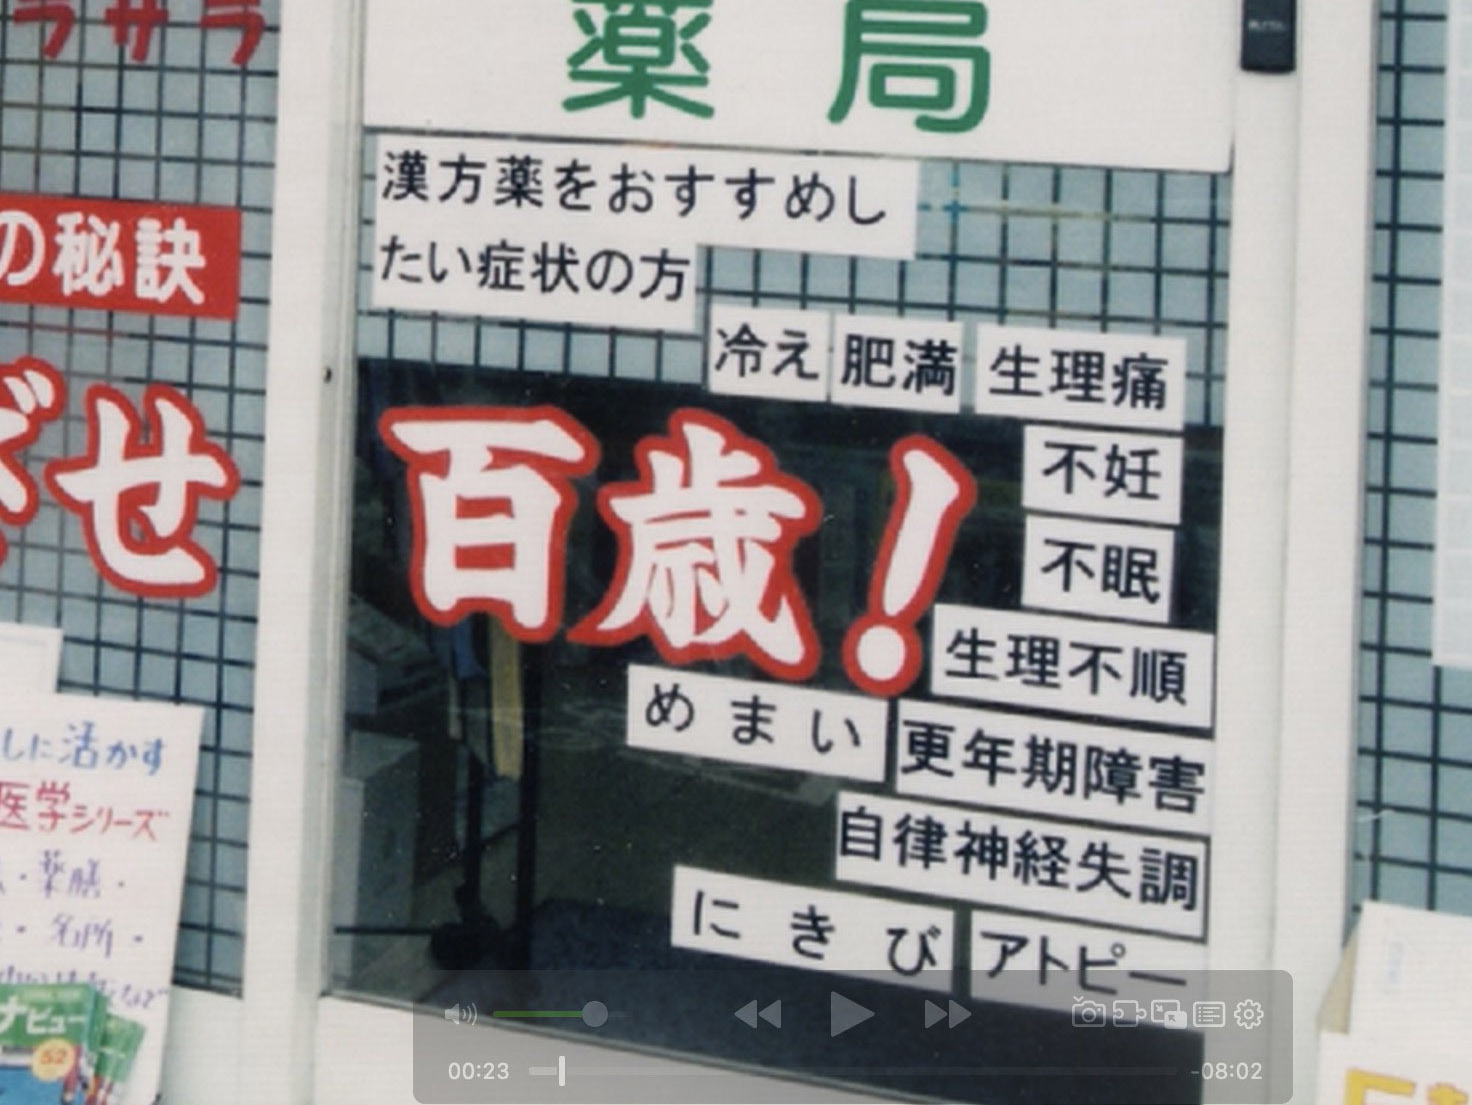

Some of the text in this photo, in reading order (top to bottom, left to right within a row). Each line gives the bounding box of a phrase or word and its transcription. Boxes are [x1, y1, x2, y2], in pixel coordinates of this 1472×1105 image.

[380, 151, 888, 226] 漢方薬をおすすめし
[380, 235, 691, 301] たい症状の方
[714, 324, 1168, 412] 冷え 肥満 生理痛
[1041, 441, 1163, 503] 不妊
[1041, 538, 1162, 605] 不眠
[945, 628, 1188, 707] 生理不順
[644, 683, 863, 753] めまい
[902, 719, 1207, 815] 更年期障害
[839, 806, 1201, 912] 自律神経失調
[692, 889, 943, 977] にきび
[980, 930, 1188, 995] アトピー
